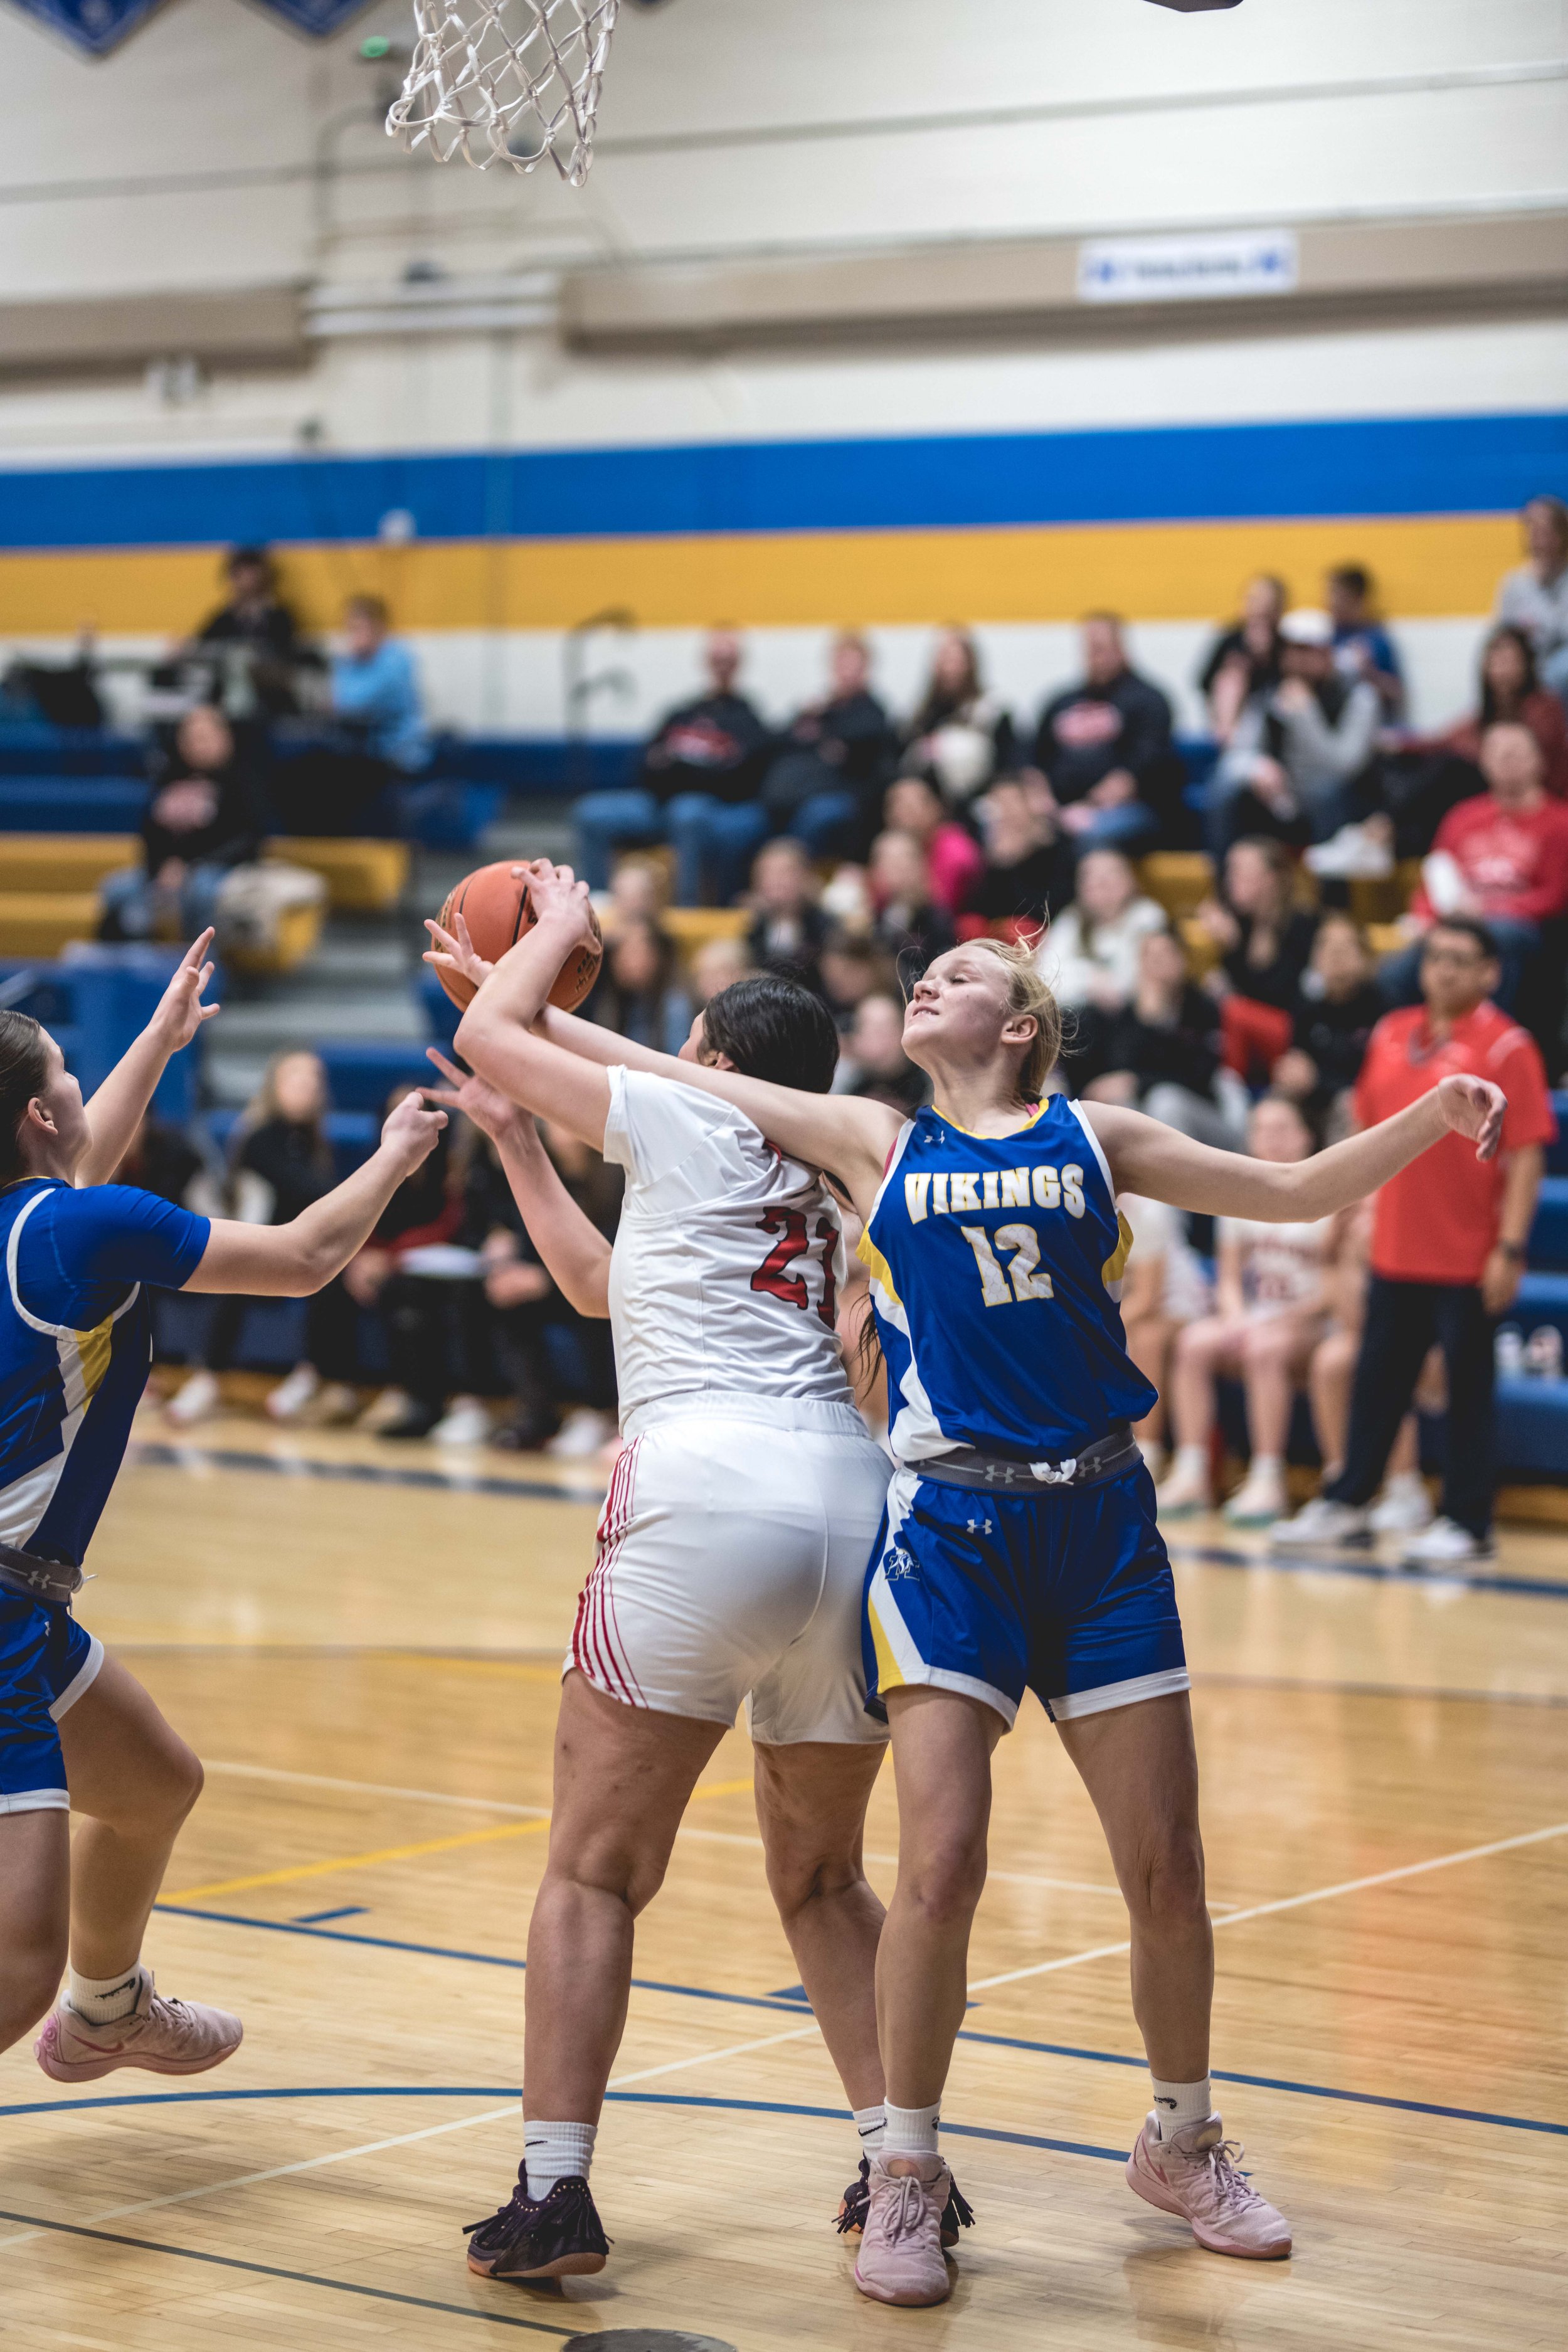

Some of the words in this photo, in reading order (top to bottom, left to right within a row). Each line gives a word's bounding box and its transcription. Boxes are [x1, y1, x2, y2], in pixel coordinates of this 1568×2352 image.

[904, 1163, 1086, 1225] VIKINGS
[750, 1205, 839, 1332] 21
[961, 1223, 1054, 1307] 12
